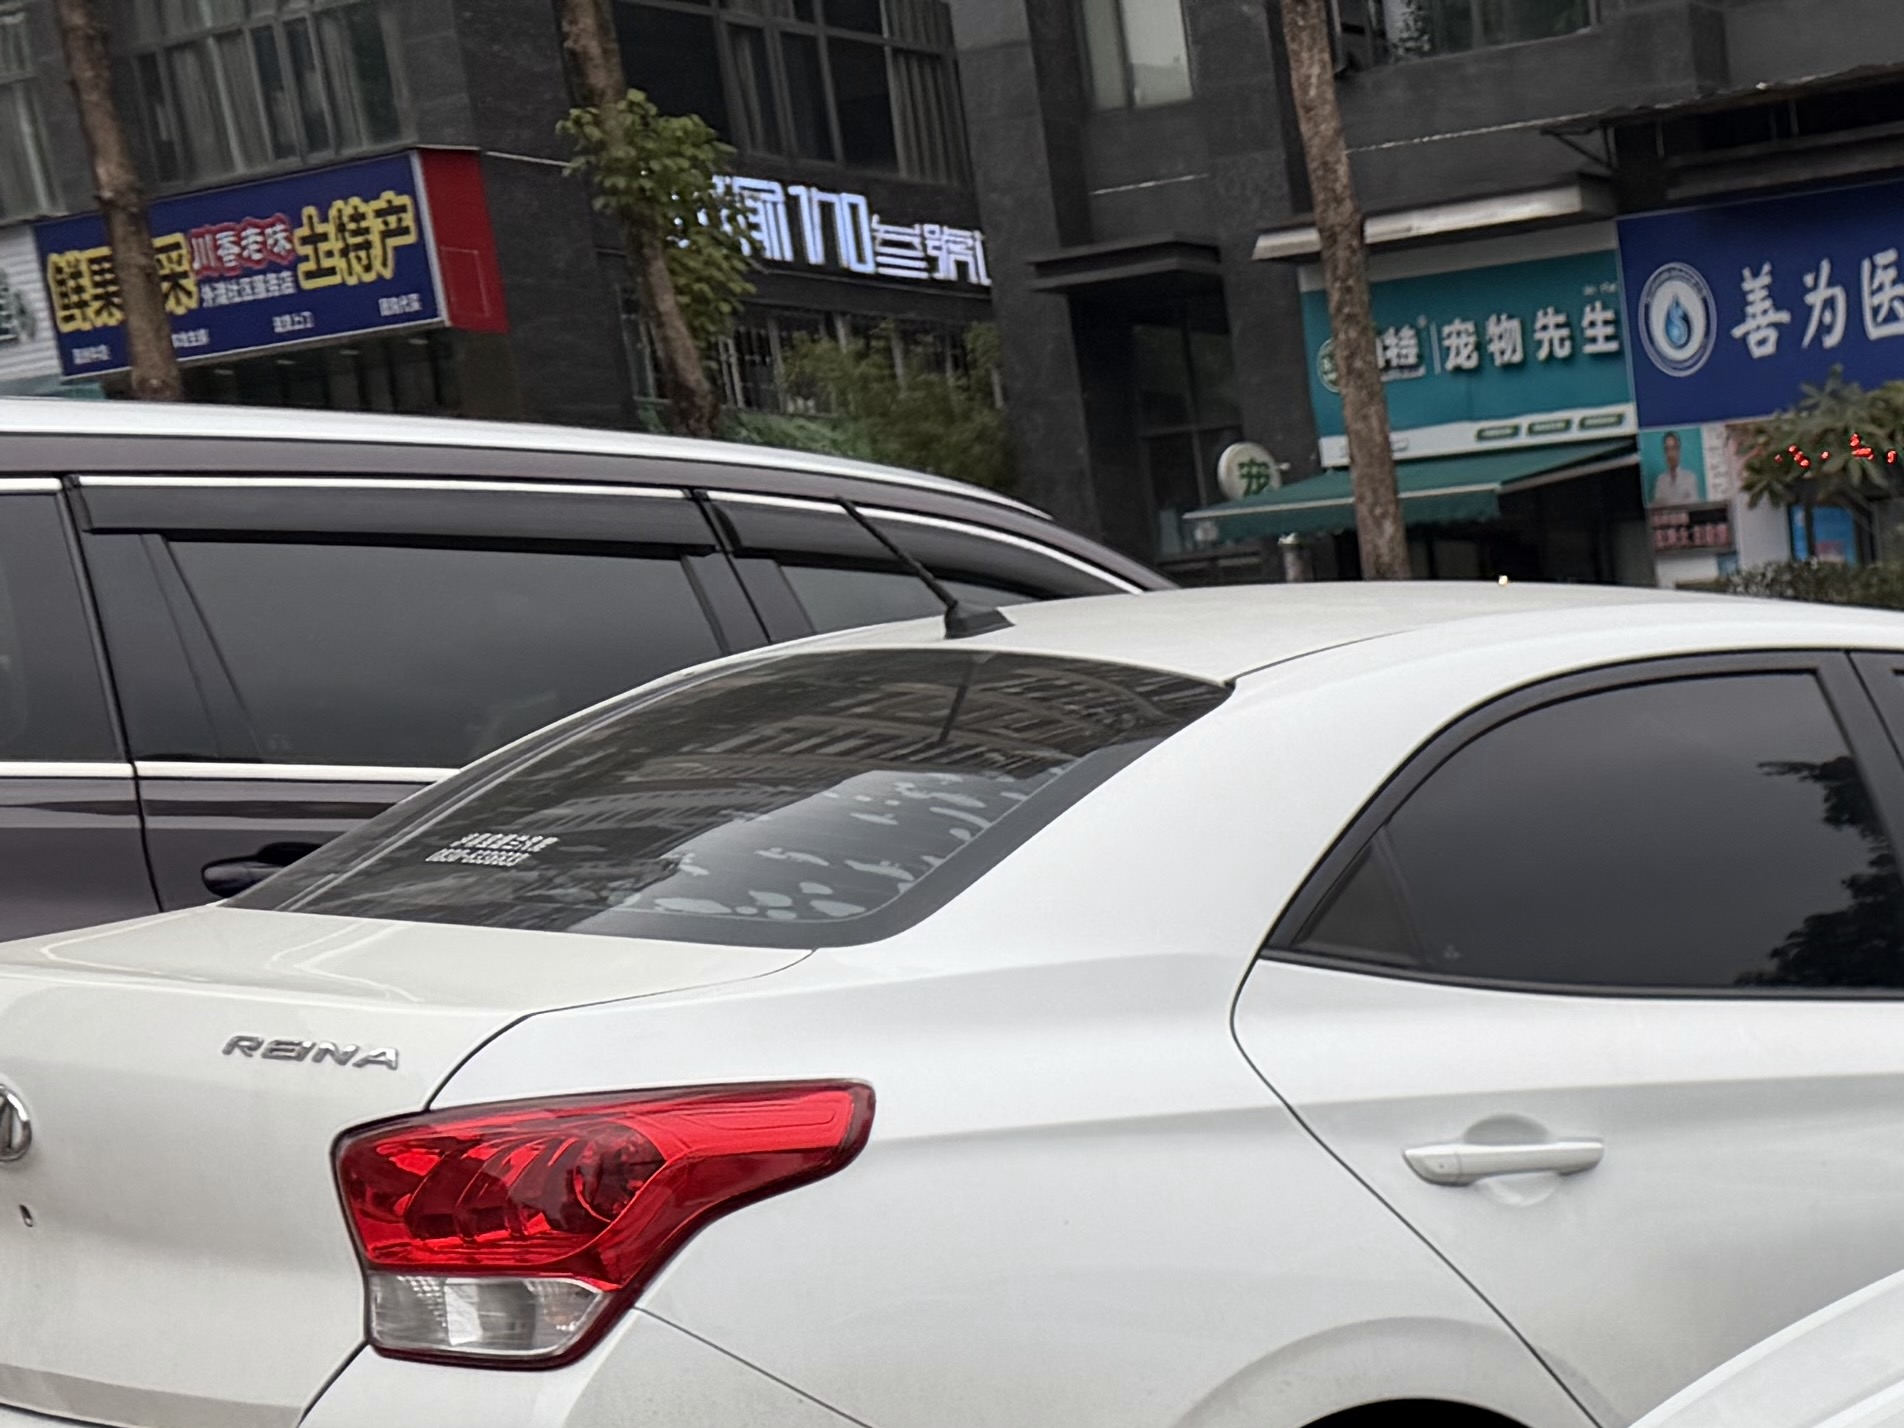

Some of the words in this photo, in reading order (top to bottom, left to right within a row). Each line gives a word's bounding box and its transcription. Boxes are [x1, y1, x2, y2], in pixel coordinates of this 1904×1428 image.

[295, 191, 418, 289] 土特产
[47, 232, 199, 333] 鲜果采
[1442, 301, 1620, 372] 宠物先生
[222, 1035, 399, 1071] REINA
